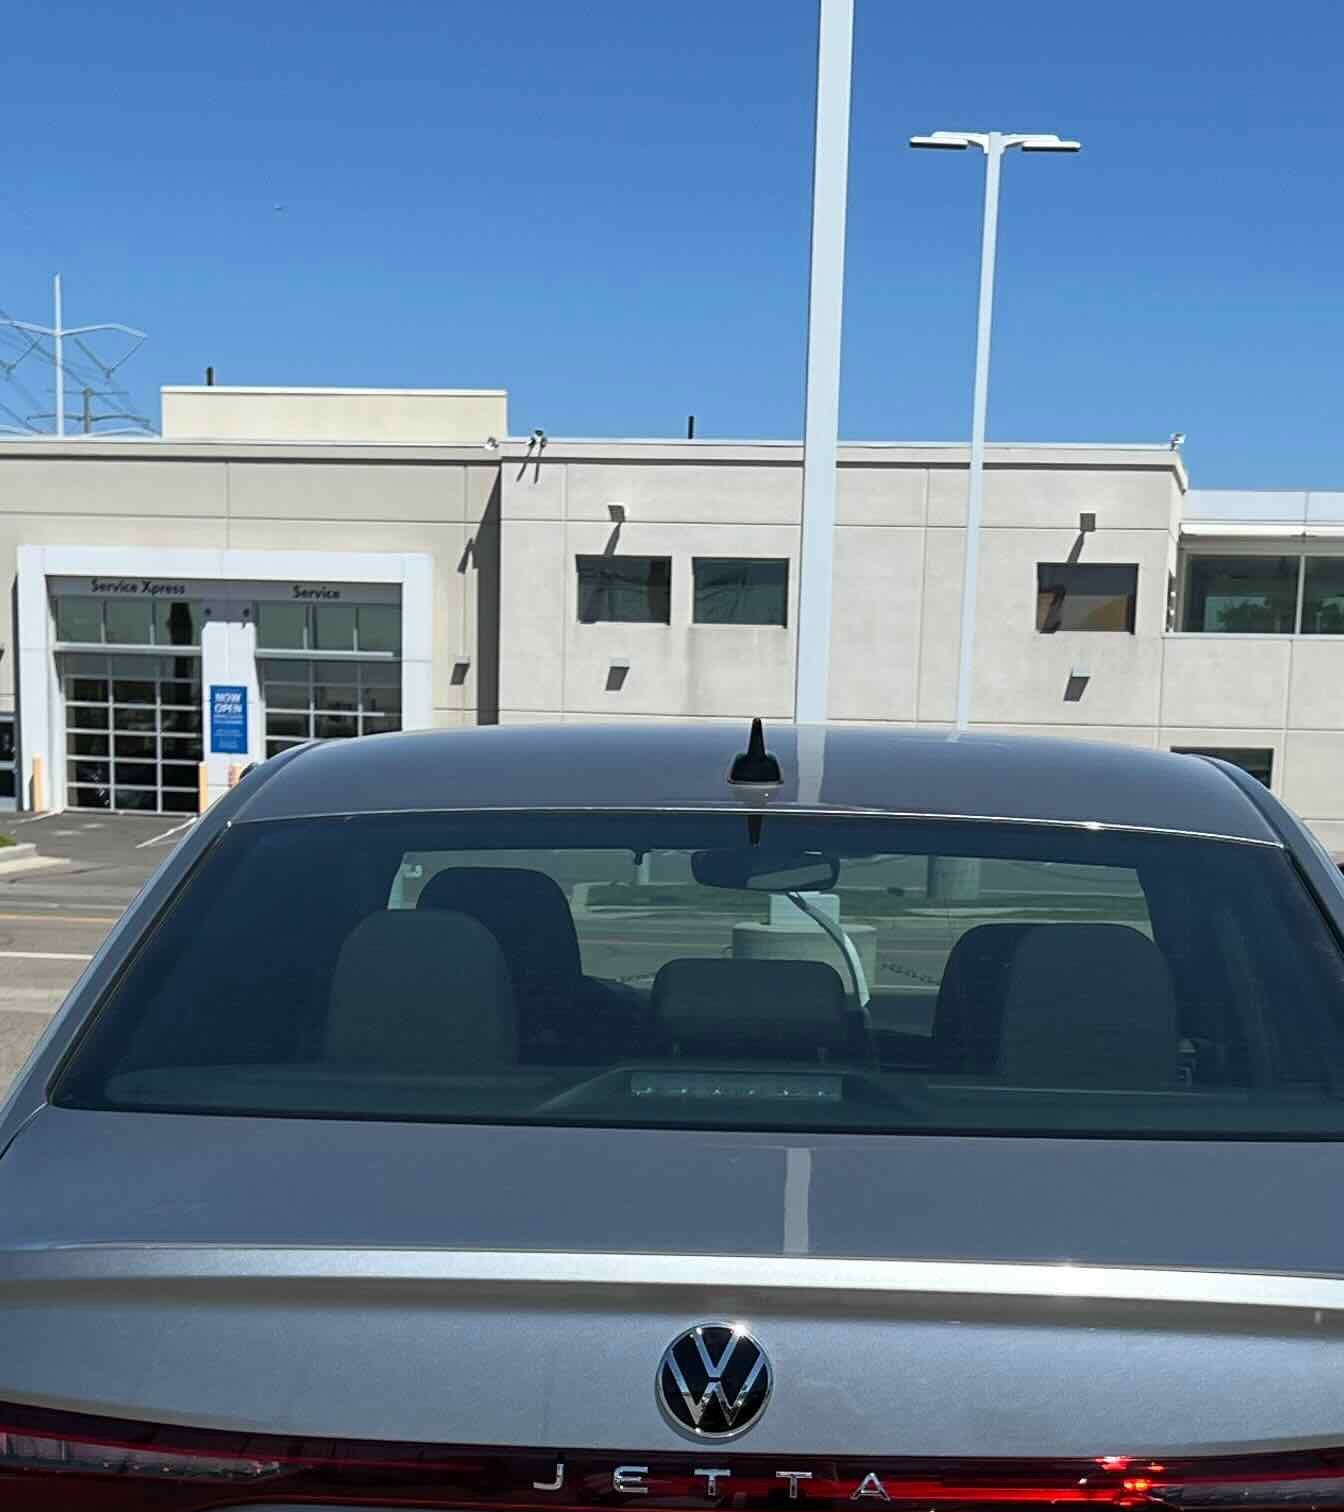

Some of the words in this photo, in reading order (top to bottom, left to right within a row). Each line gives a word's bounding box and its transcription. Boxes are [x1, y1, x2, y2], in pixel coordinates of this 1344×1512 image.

[90, 578, 137, 594] Service
[142, 581, 186, 596] Xpress
[293, 585, 341, 600] Service
[533, 1463, 891, 1502] JETTA
